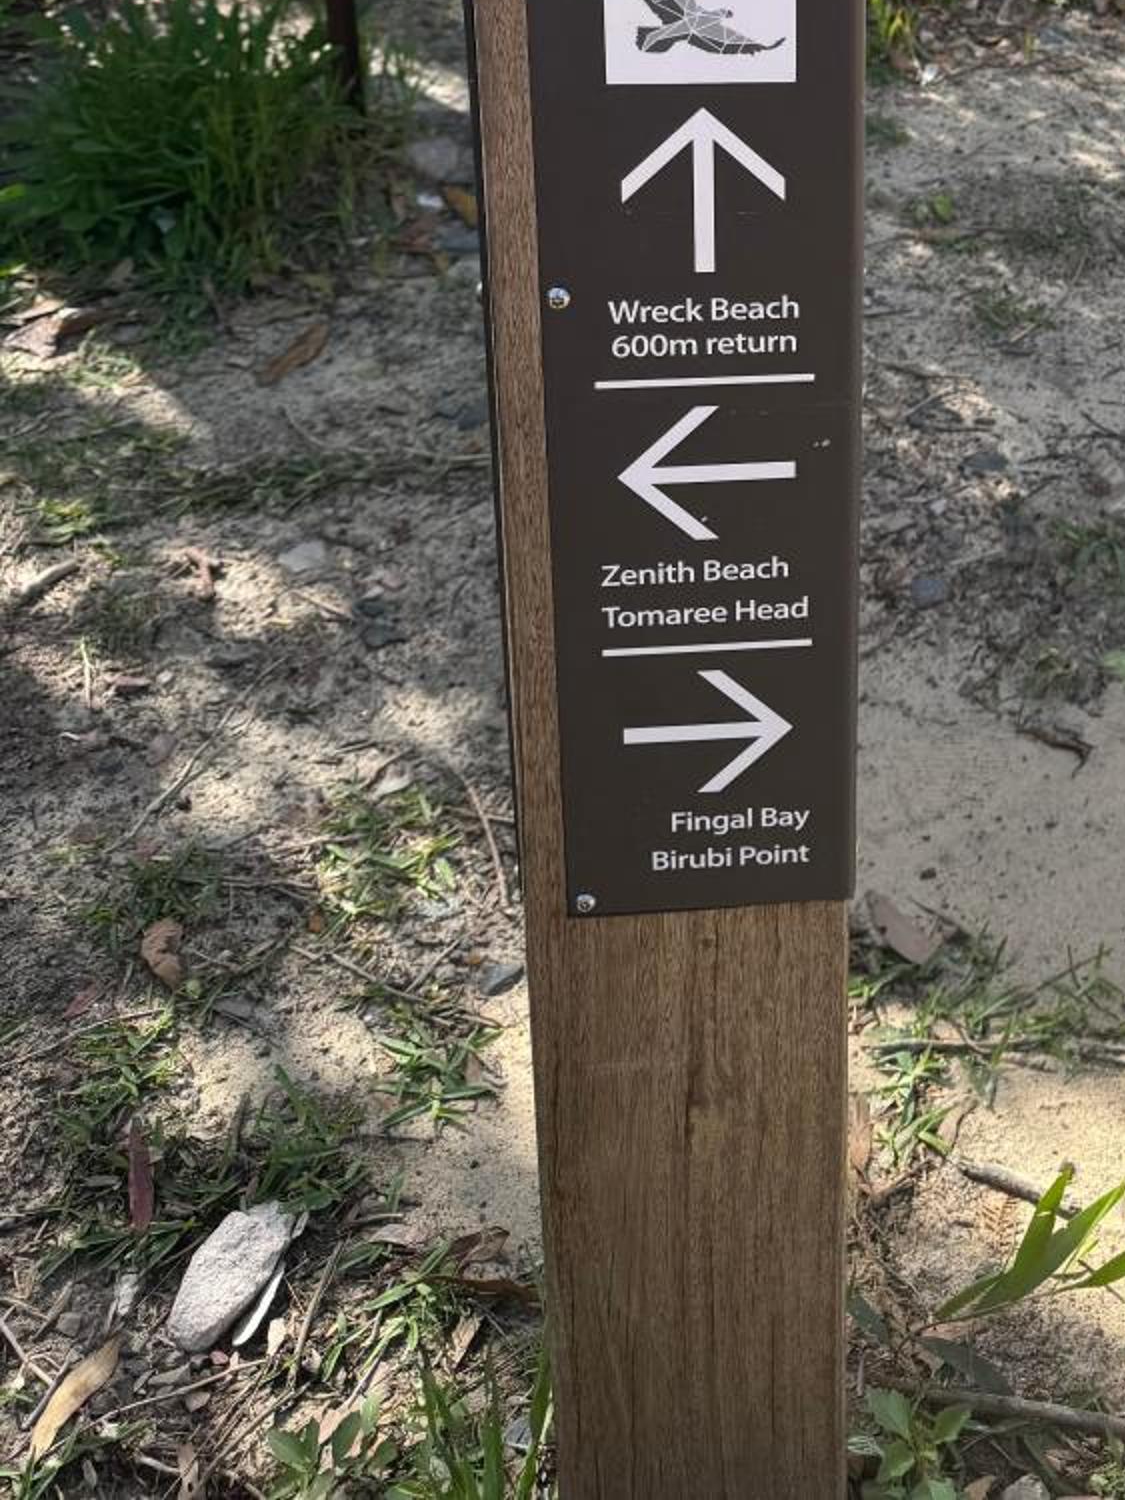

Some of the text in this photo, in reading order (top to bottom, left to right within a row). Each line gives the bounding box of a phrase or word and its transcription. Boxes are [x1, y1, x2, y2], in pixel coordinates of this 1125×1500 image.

[608, 294, 800, 324] Wreck Beach
[611, 333, 798, 357] 600m return
[601, 556, 789, 587] Zenith Beach
[601, 596, 809, 628] Tomaree Head
[671, 807, 810, 834] Fingal Bay
[652, 844, 810, 871] Birubi Point
